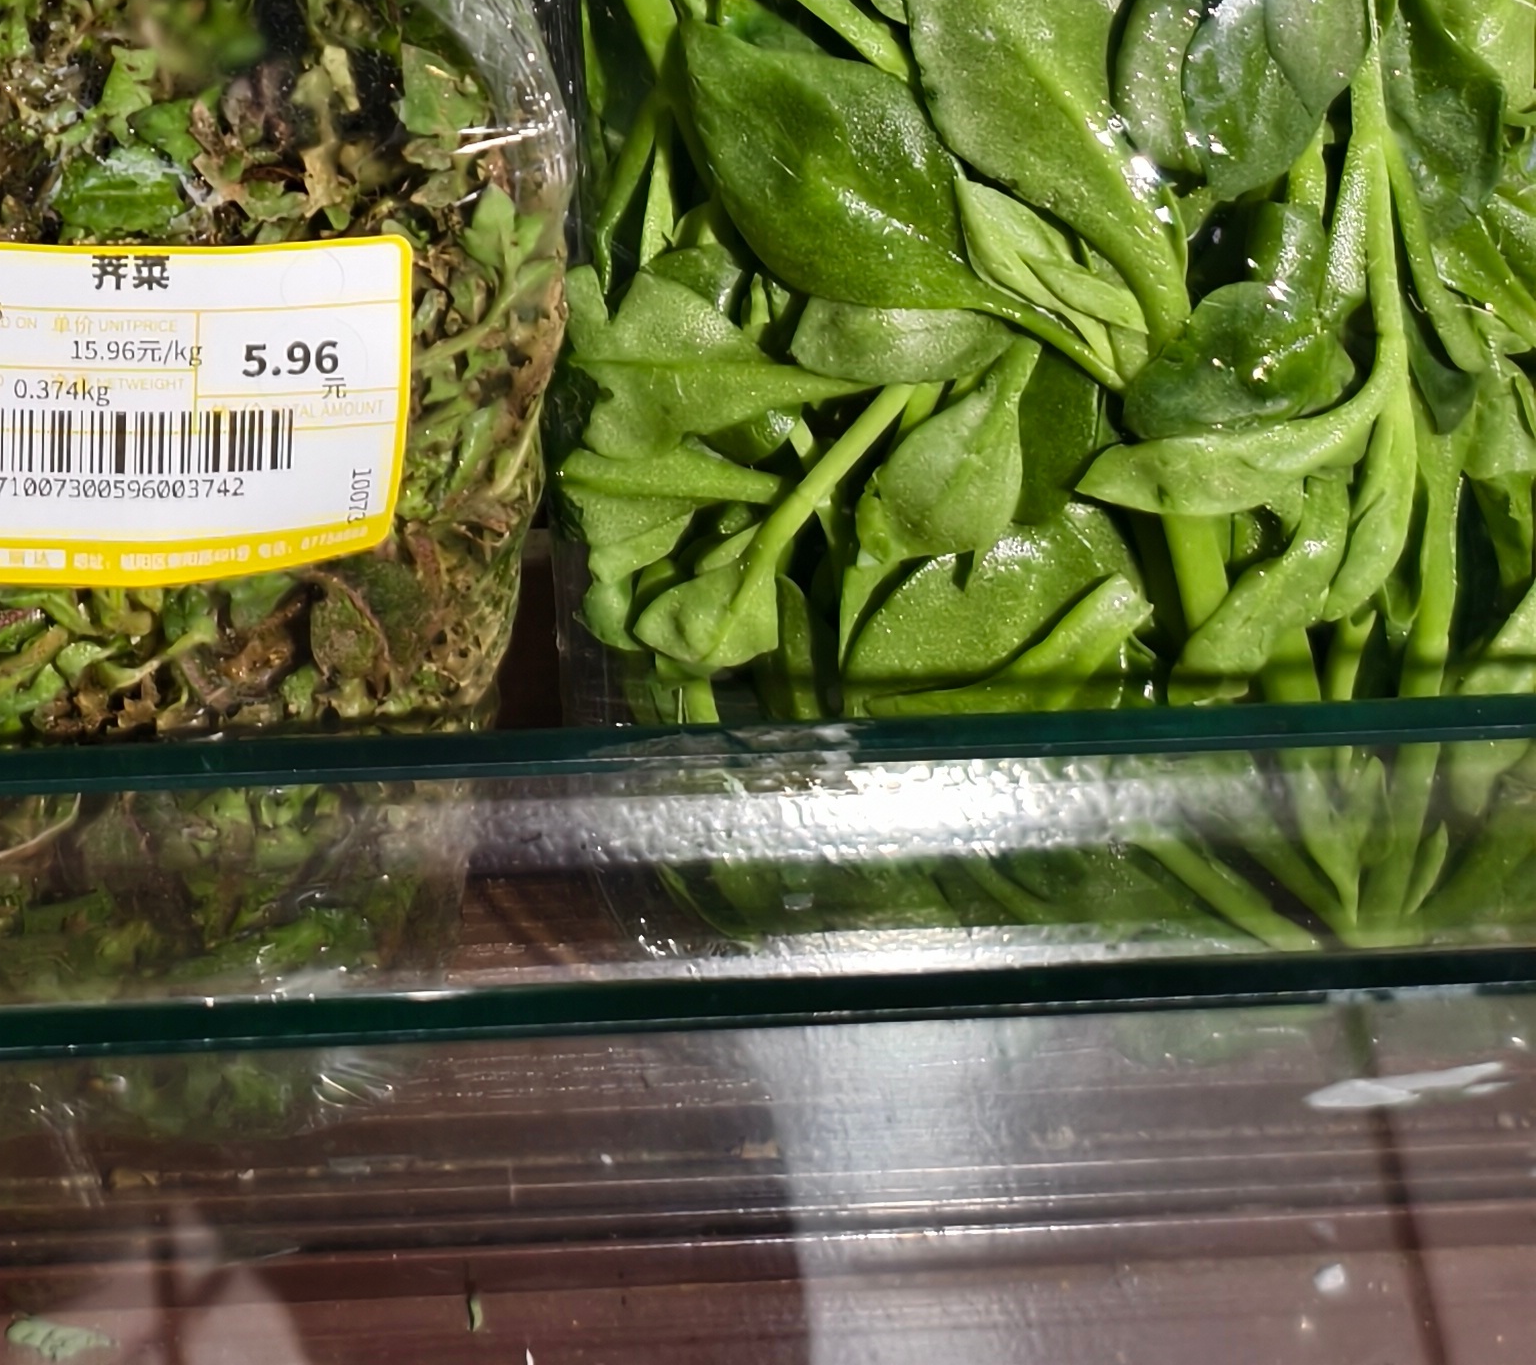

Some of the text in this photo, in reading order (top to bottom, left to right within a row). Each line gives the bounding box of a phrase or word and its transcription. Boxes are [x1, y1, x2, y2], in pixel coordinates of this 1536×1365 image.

[92, 254, 171, 292] 荠菜
[70, 339, 203, 366] 15.96元/kg
[242, 340, 340, 378] 5.96
[14, 378, 110, 407] 0.374kg
[322, 377, 347, 400] 元
[348, 467, 371, 525] 10073
